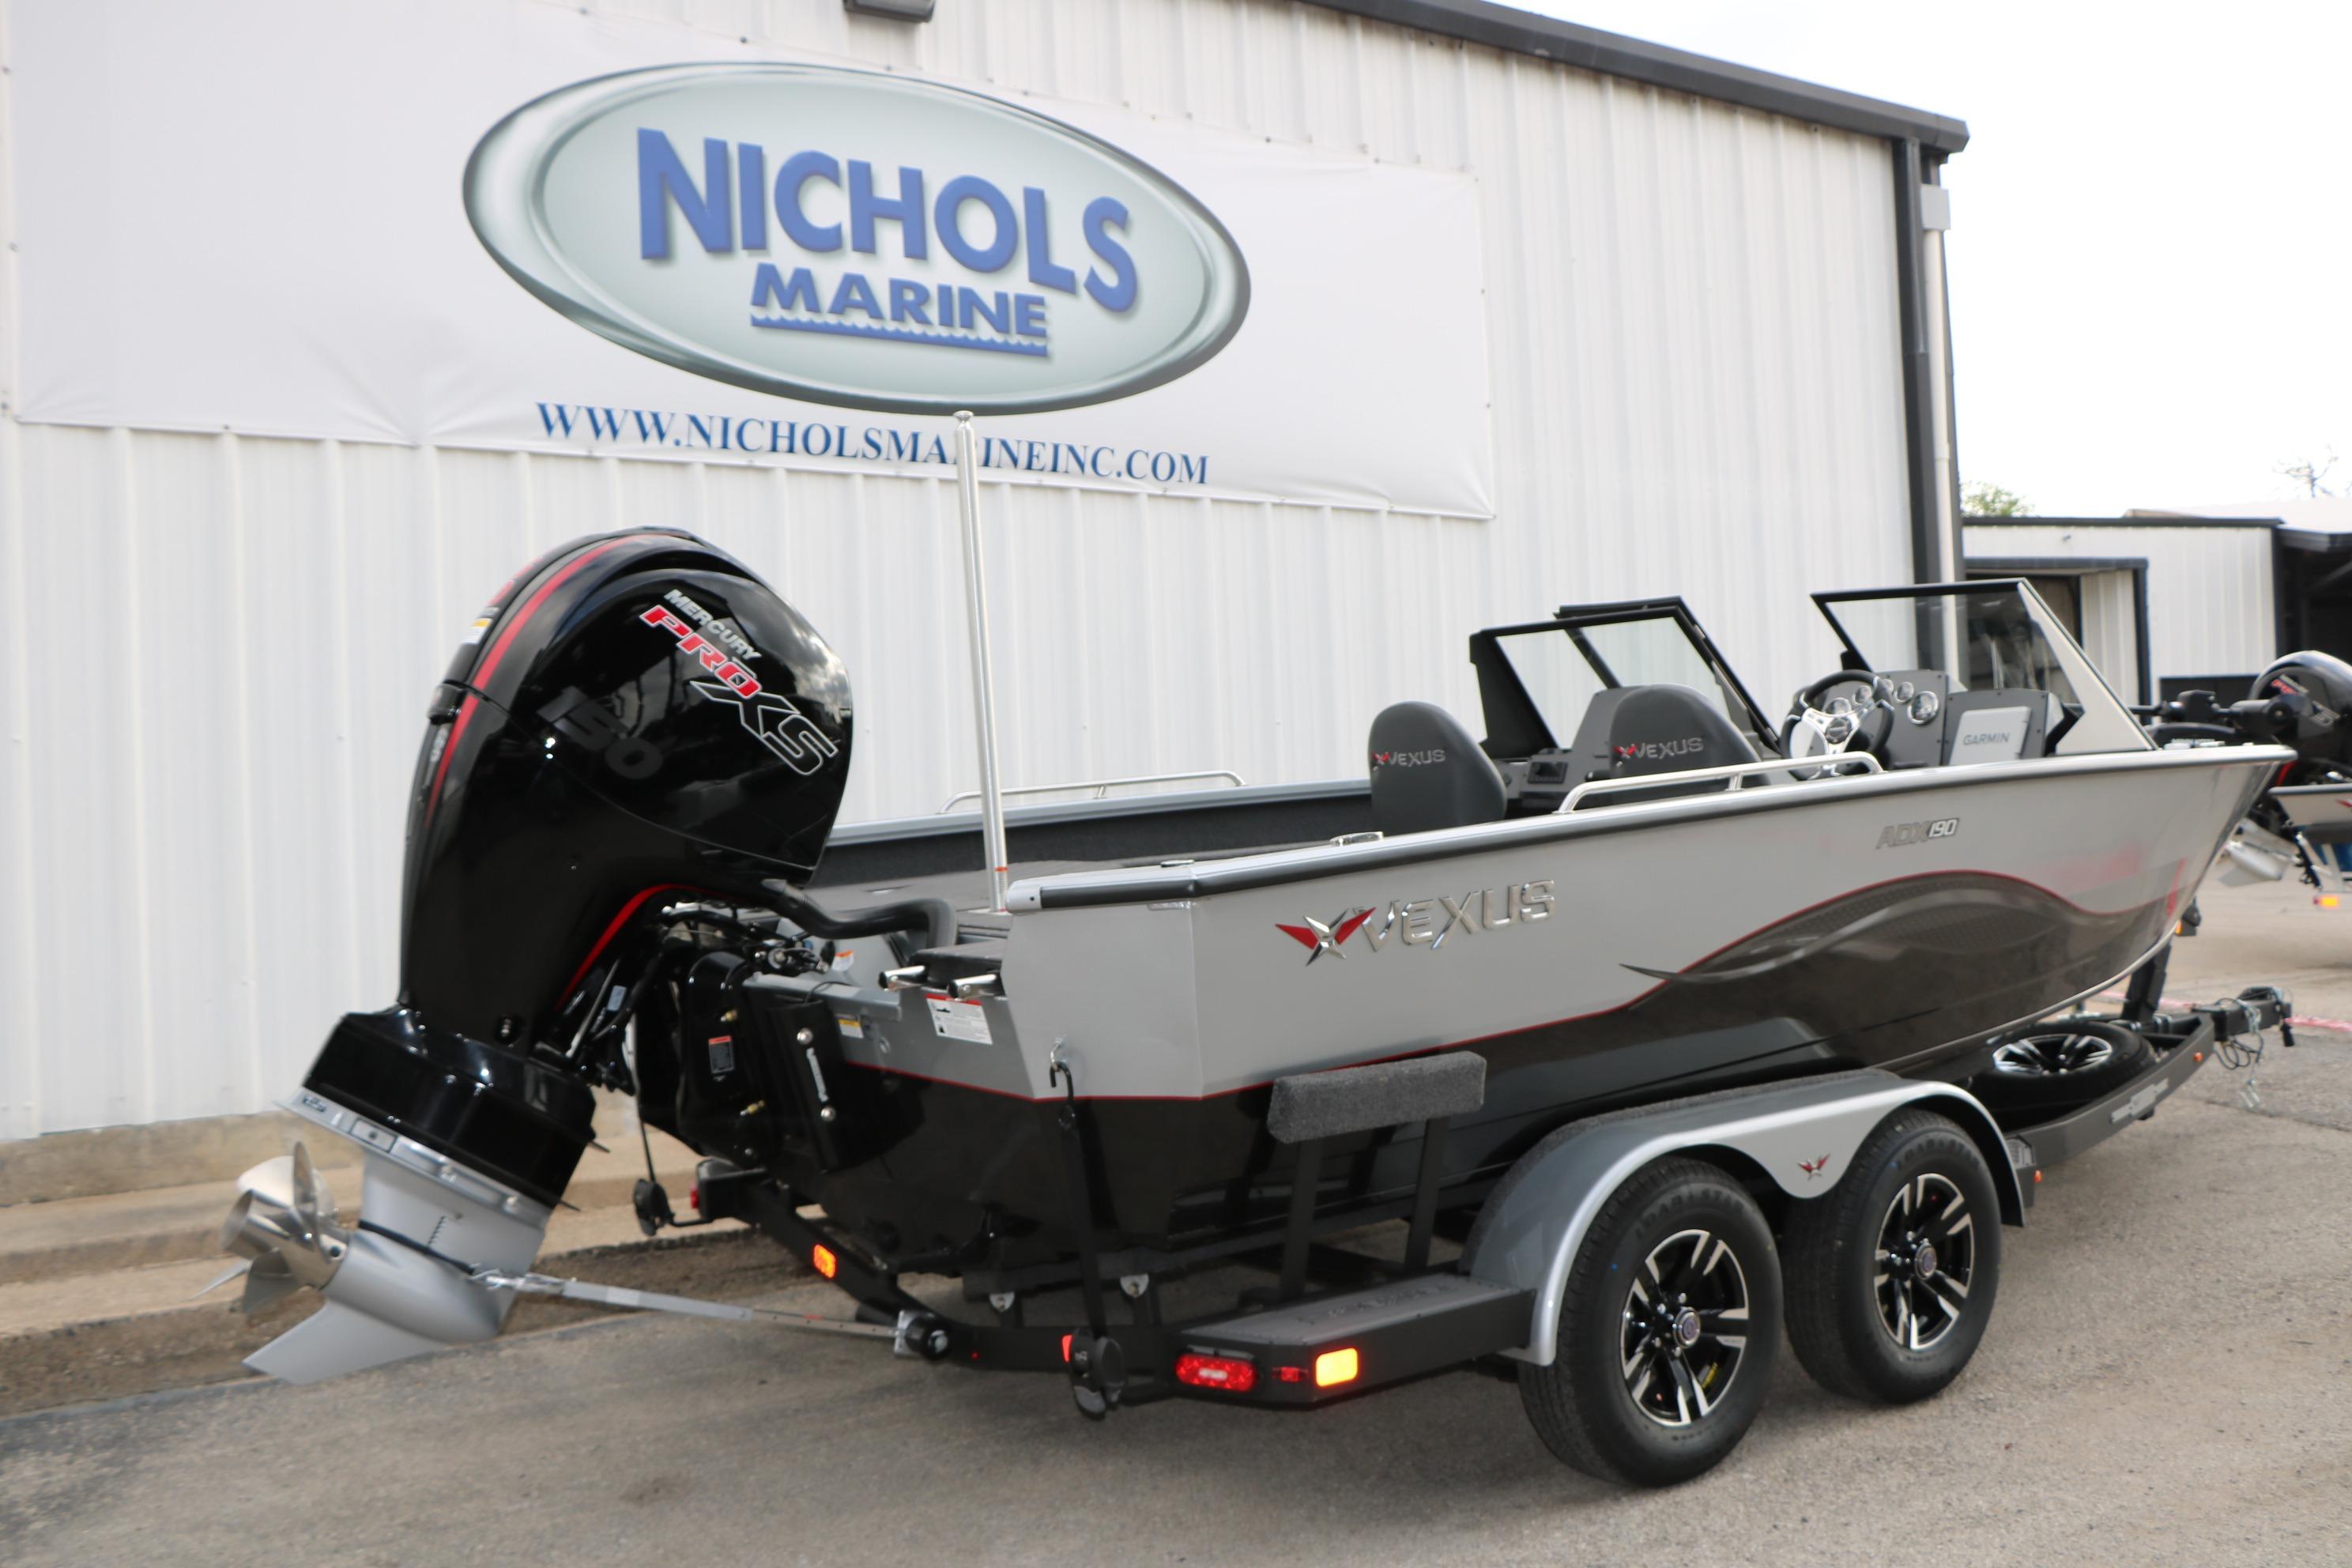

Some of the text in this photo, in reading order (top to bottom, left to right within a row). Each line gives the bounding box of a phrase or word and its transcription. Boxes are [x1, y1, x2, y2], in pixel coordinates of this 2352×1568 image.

[637, 126, 1139, 315] NICHOLS
[750, 262, 1050, 340] MARINE
[536, 402, 1209, 485] WWW.NICHOLSMAINEINC.COM
[663, 589, 762, 660] MERCURY
[639, 604, 839, 775] PRO XS
[536, 684, 664, 780] 150
[1388, 748, 1446, 767] VEXUS
[1634, 737, 1705, 760] VEXUS
[1962, 732, 2010, 746] GARMIN
[1353, 879, 1555, 952] VEXUS
